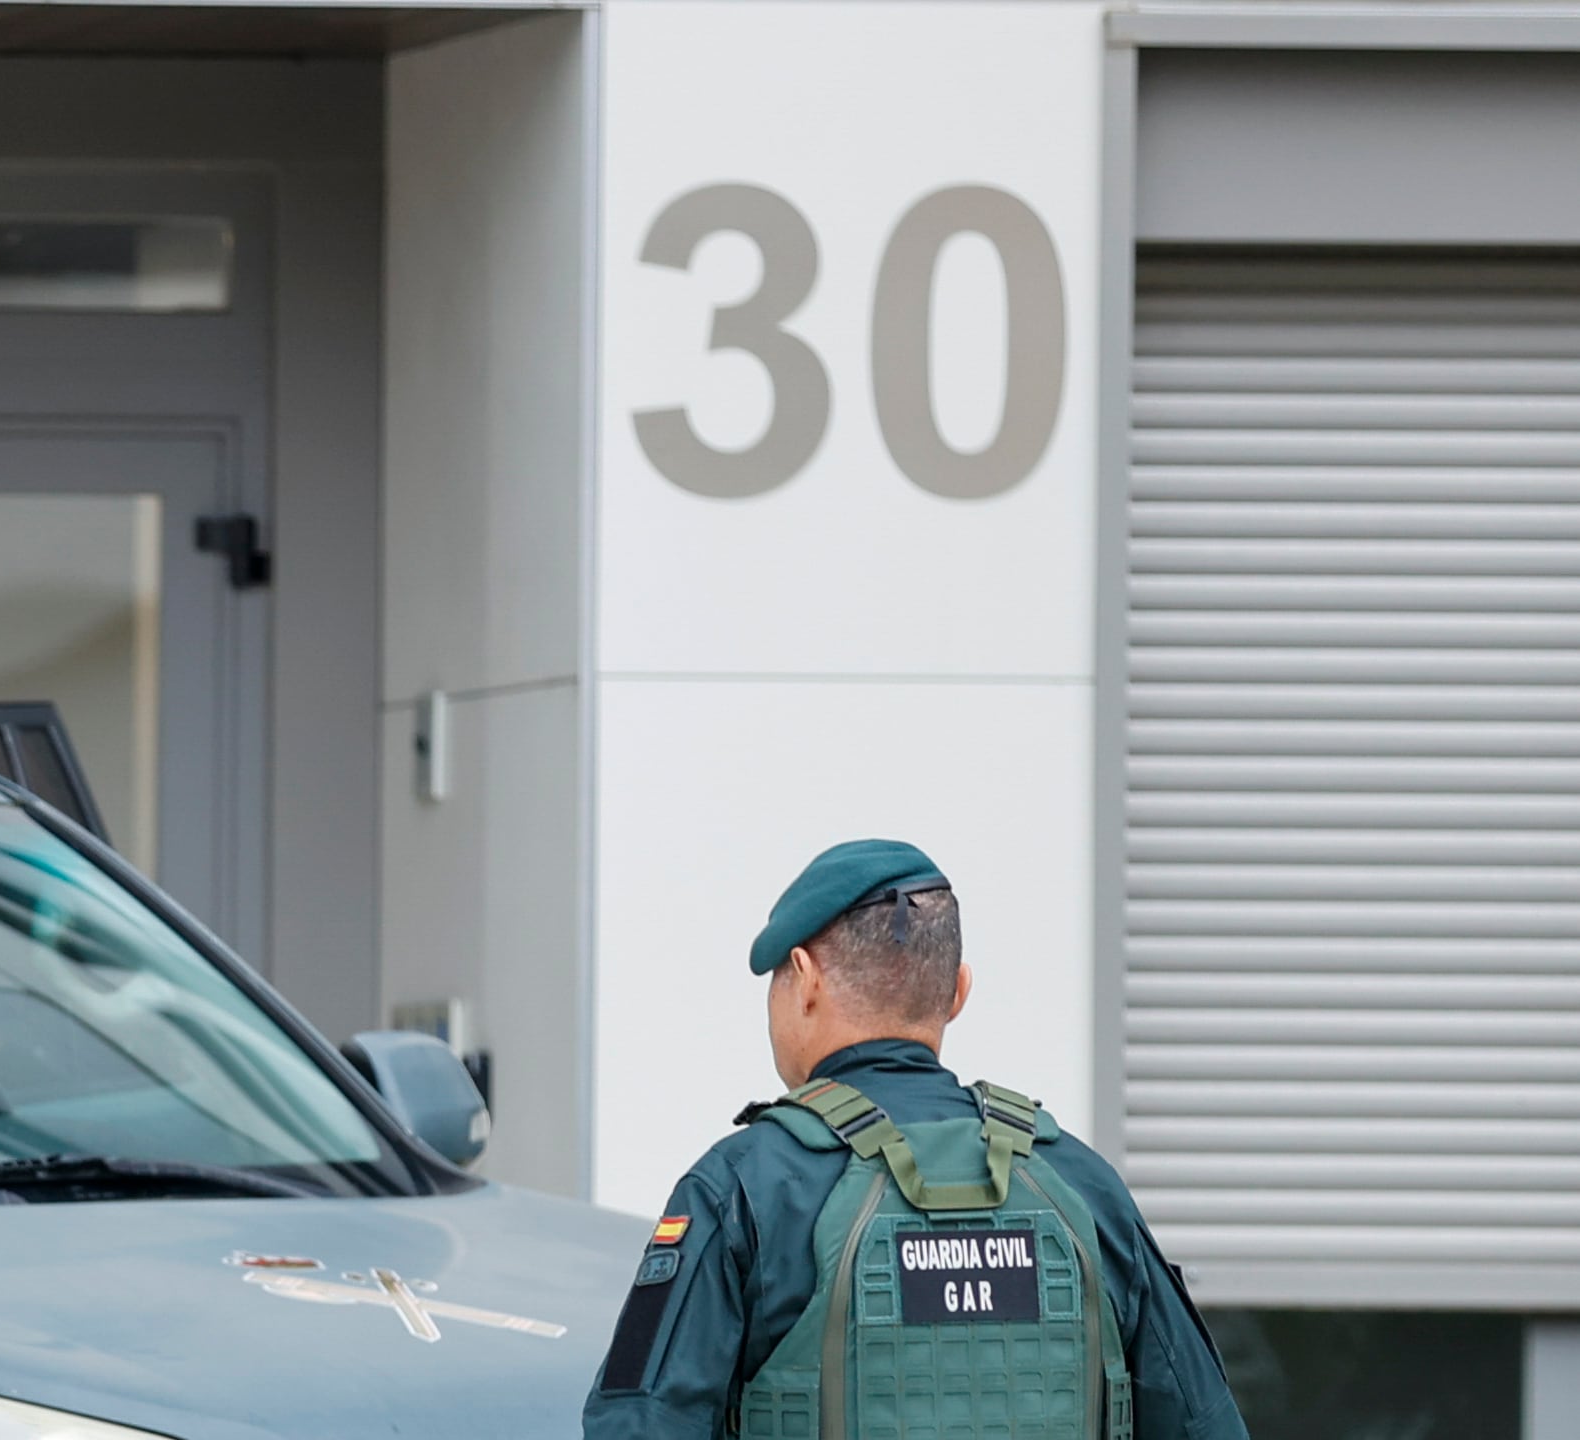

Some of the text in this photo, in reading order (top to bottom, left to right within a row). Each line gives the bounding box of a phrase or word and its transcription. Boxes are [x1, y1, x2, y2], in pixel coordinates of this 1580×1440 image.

[632, 180, 1067, 502] 30
[901, 1237, 1033, 1271] GUARDIA CIVIL
